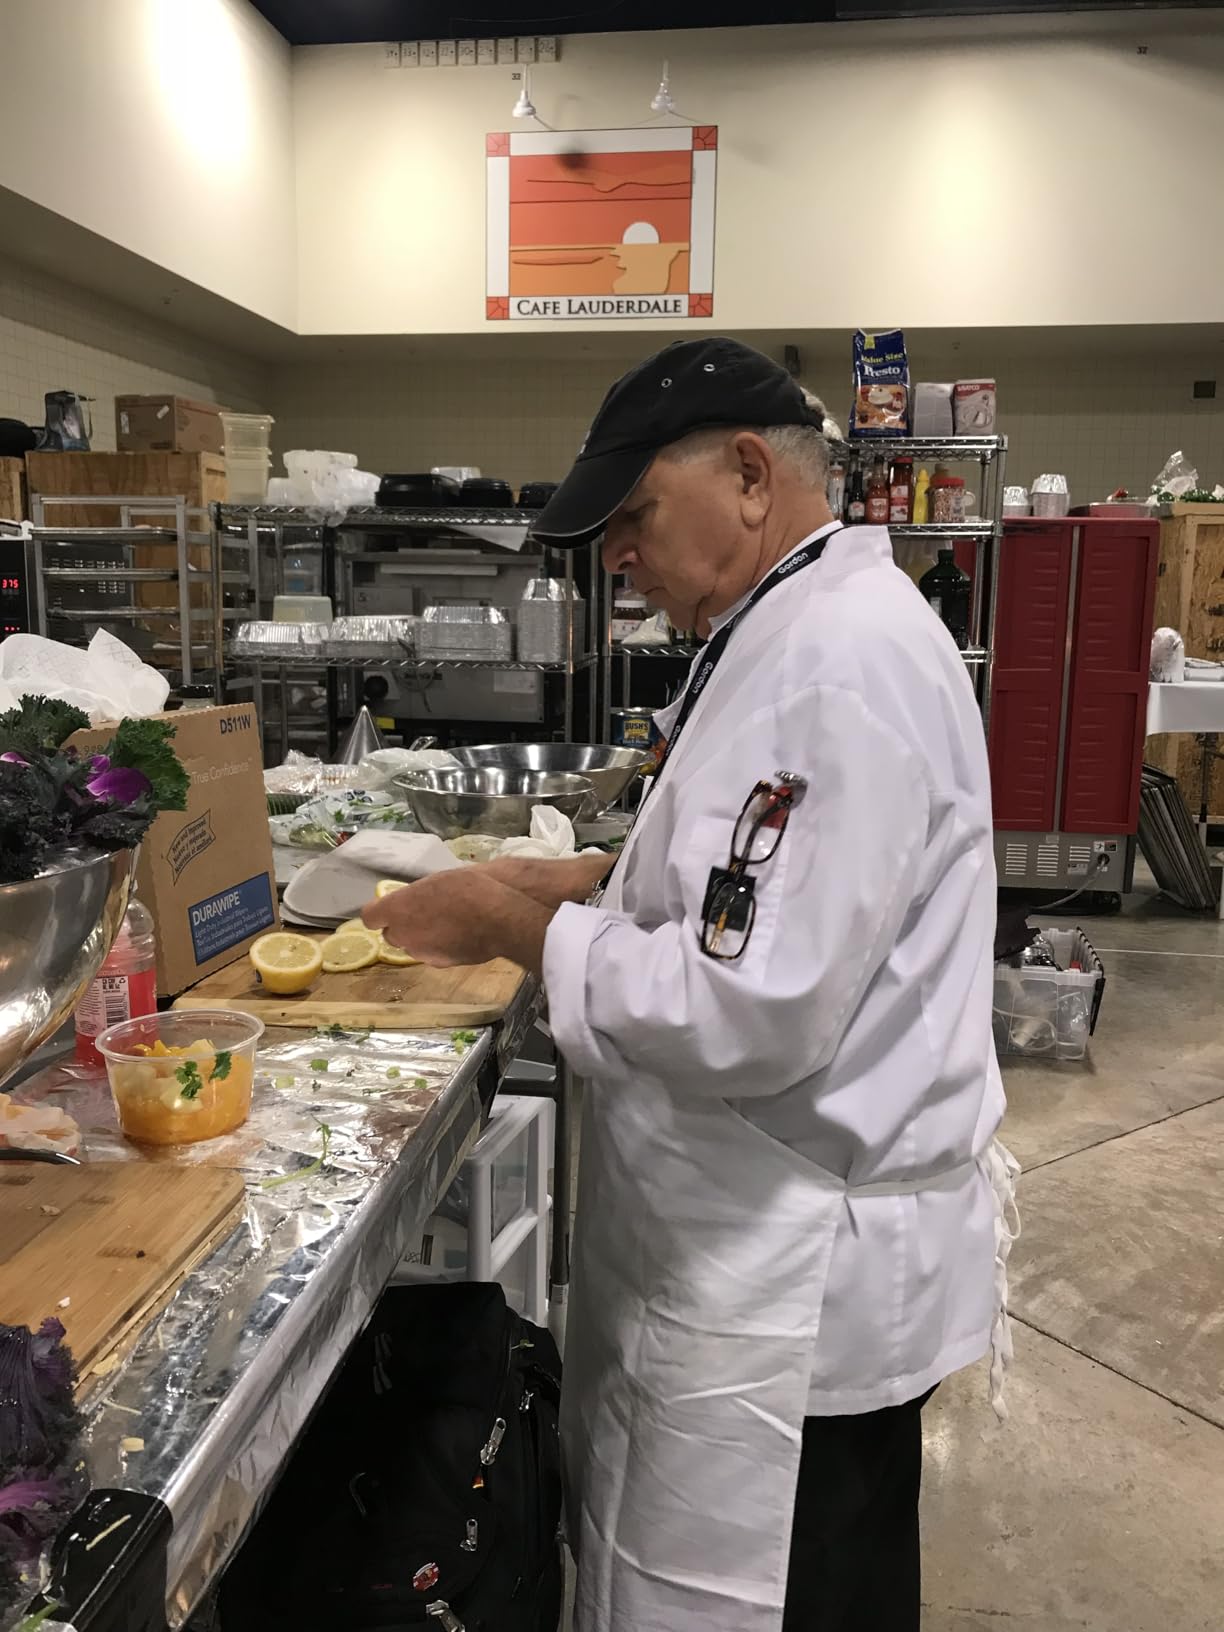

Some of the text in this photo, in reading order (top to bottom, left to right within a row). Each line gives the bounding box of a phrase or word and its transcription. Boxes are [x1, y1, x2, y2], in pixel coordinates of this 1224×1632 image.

[517, 298, 682, 315] CAFE LAUDERDALE
[885, 351, 904, 362] Size
[863, 364, 901, 378] Presto
[777, 551, 809, 575] Gordon
[692, 661, 714, 695] Gordon
[220, 714, 251, 735] D511W
[192, 890, 241, 926] DURAWIPE
